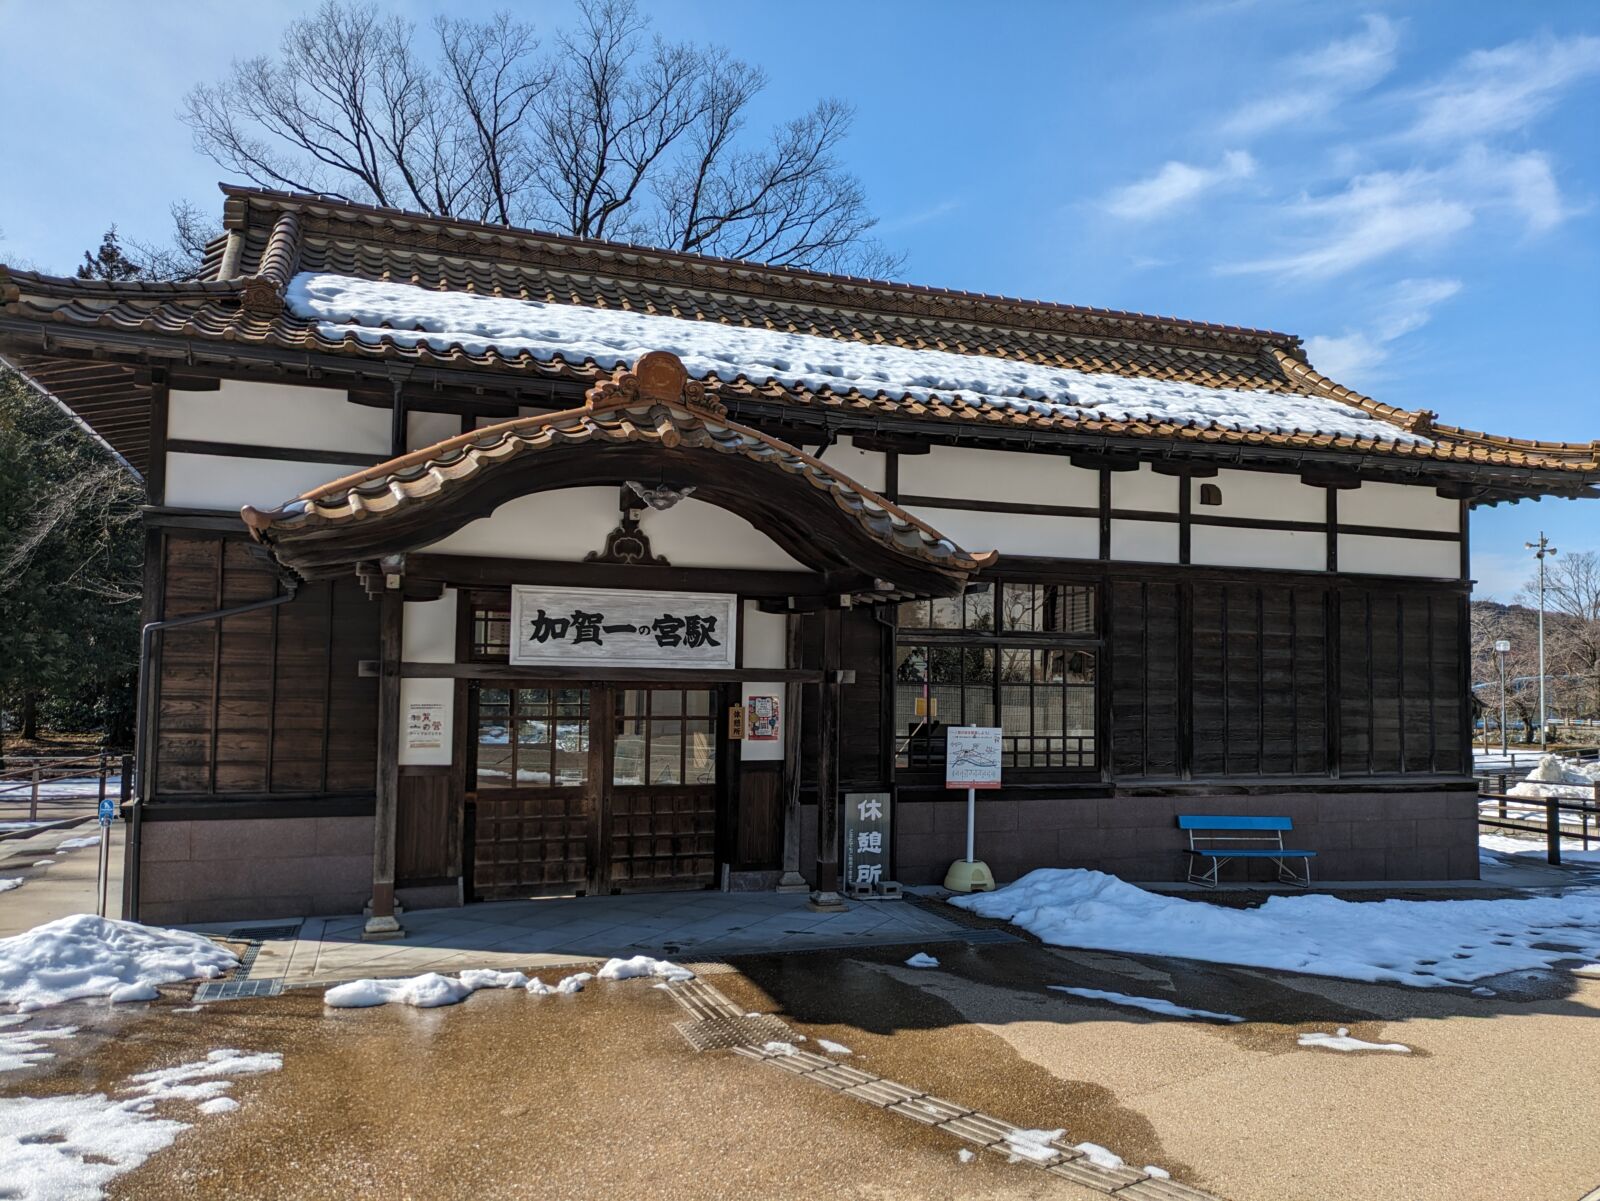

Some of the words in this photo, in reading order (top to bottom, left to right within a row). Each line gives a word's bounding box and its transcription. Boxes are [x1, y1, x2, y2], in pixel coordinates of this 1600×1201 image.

[528, 609, 721, 649] 加賀一の宮駅
[857, 799, 882, 885] 休憩所
